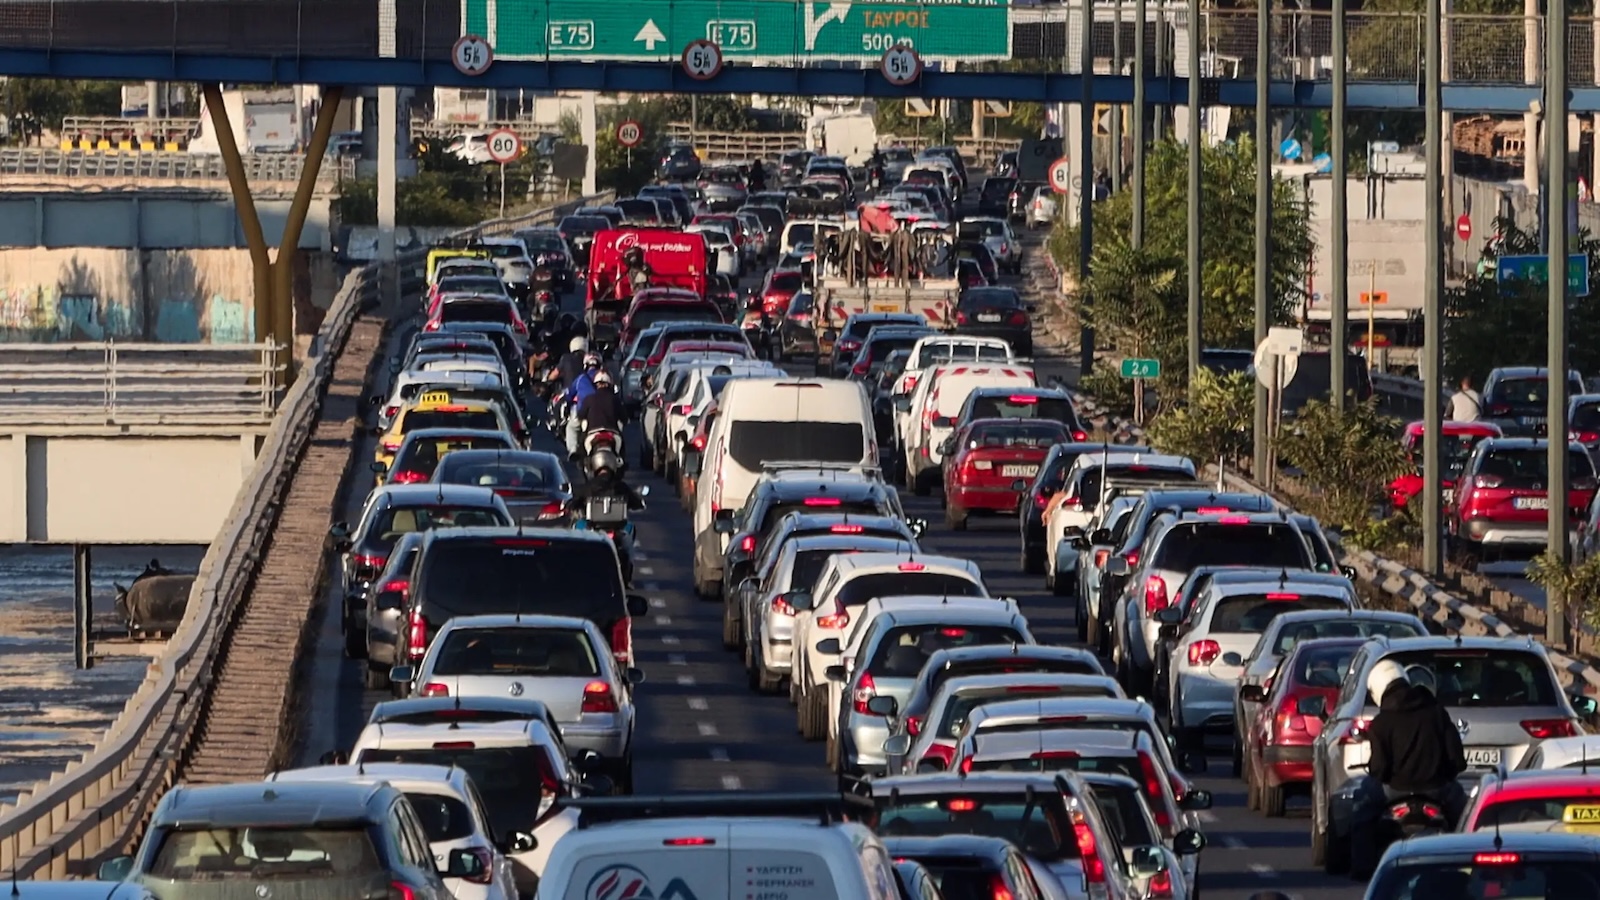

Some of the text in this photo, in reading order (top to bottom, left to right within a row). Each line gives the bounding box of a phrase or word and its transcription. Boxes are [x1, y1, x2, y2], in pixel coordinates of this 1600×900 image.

[863, 10, 930, 28] ΤΑΥΡΟΣ
[551, 26, 590, 45] E 75
[712, 26, 751, 46] E 75
[862, 33, 894, 51] 500
[622, 127, 637, 140] 80
[494, 138, 513, 152] 80
[1056, 169, 1066, 182] 8
[755, 865, 803, 874] ΥΔΡΕΥΣΗ
[755, 879, 815, 888] ΘΕΡΜΑΝΣΗ
